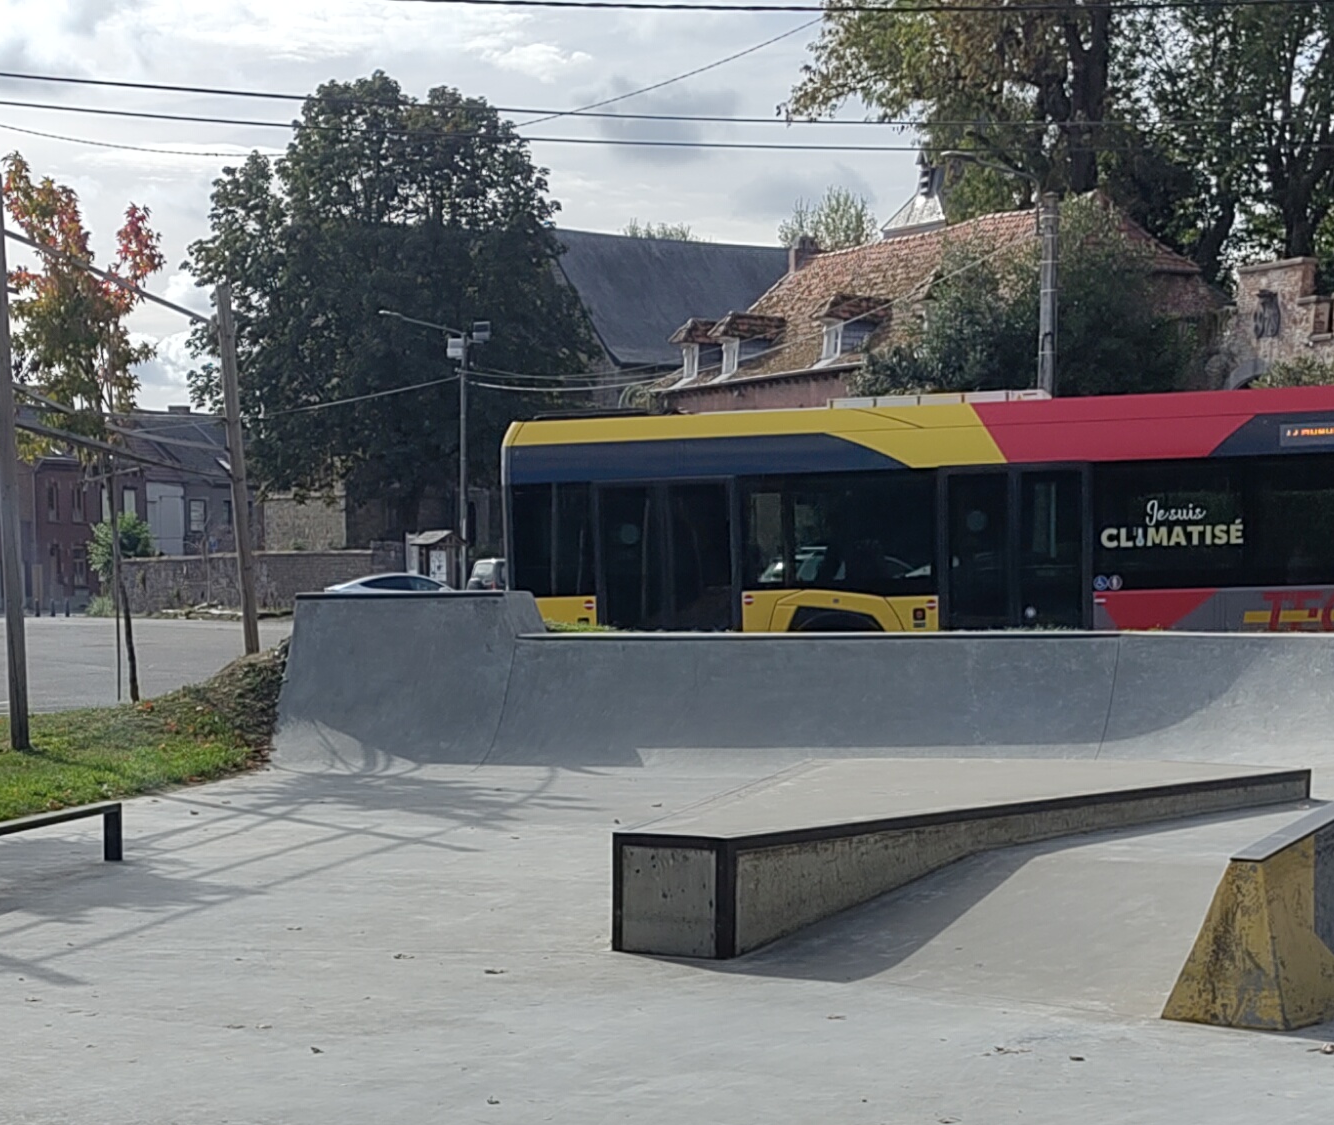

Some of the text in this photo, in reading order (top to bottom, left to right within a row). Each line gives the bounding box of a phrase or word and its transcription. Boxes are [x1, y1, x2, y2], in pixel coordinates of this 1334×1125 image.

[1145, 499, 1207, 527] Je suis
[1100, 519, 1244, 548] CLIMATISÉ
